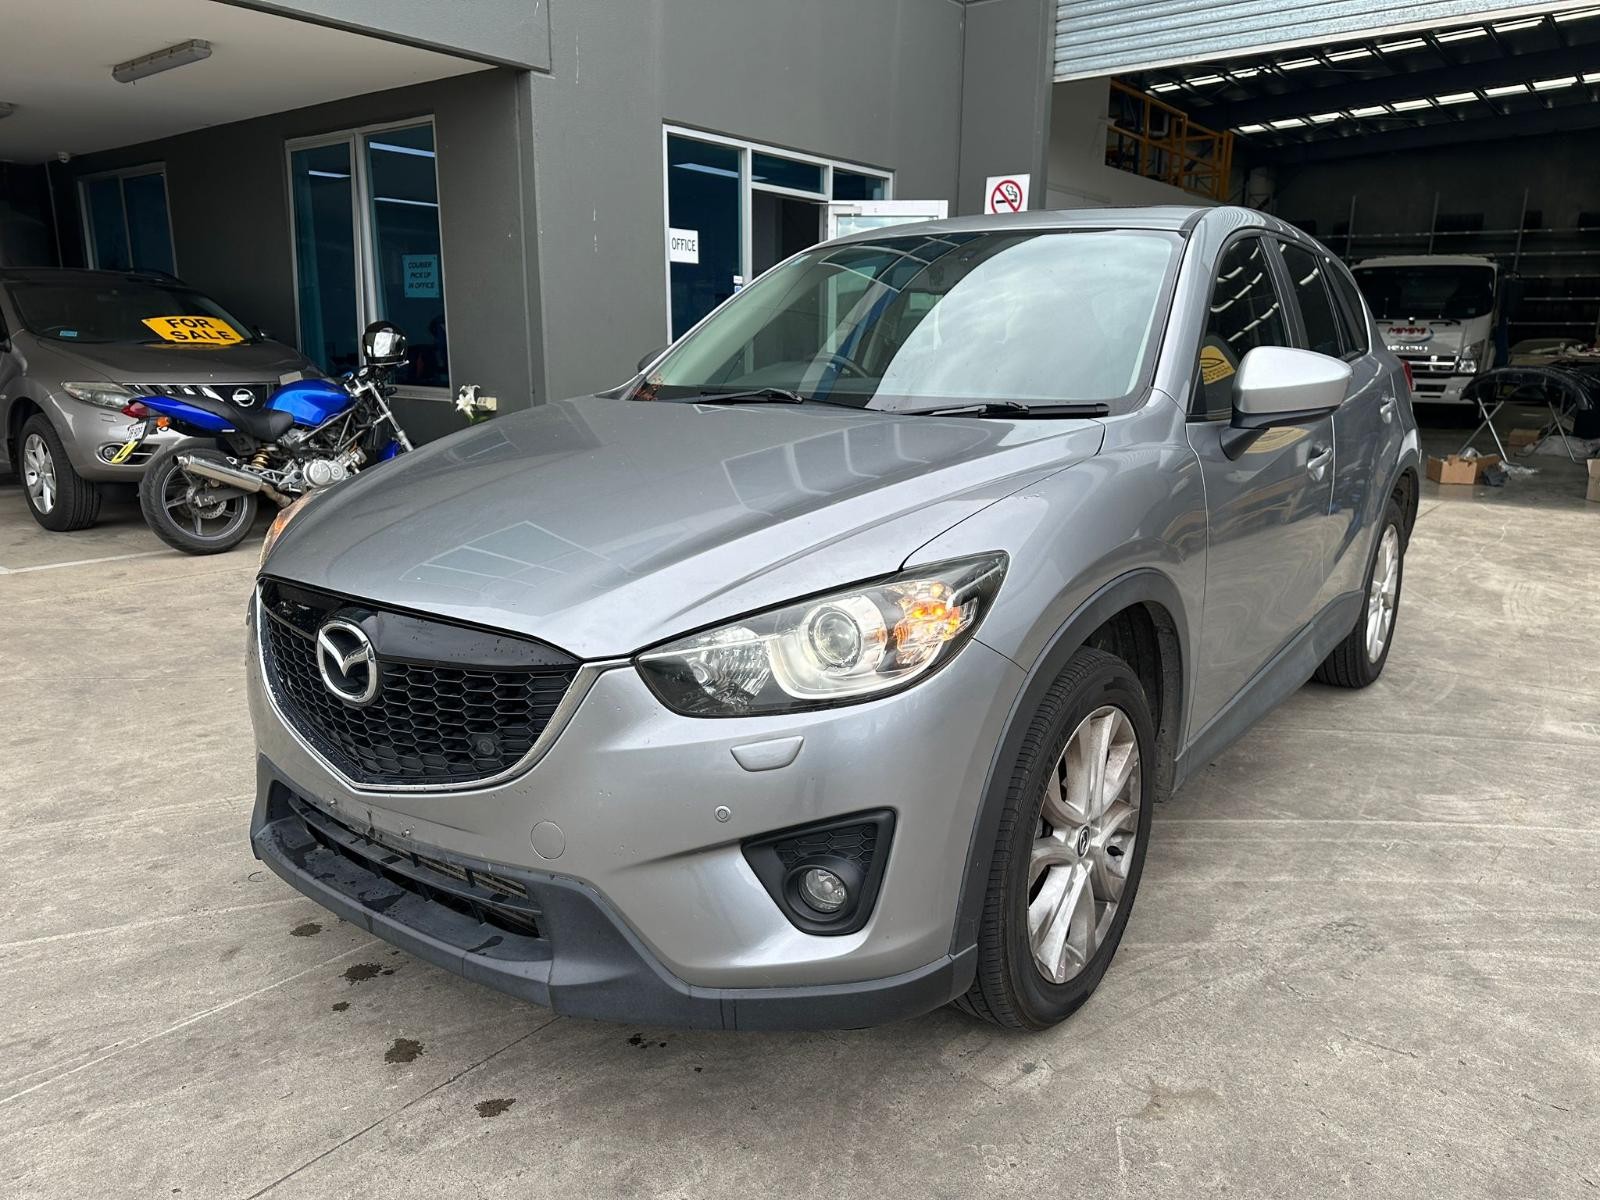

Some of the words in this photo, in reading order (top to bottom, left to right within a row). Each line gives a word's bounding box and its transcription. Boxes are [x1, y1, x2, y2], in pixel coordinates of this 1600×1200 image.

[671, 237, 697, 252] OFFICE
[408, 261, 433, 269] COURIER
[408, 281, 414, 289] IN
[415, 281, 435, 289] OFFICE
[165, 318, 214, 329] FOR
[170, 329, 235, 341] SALE
